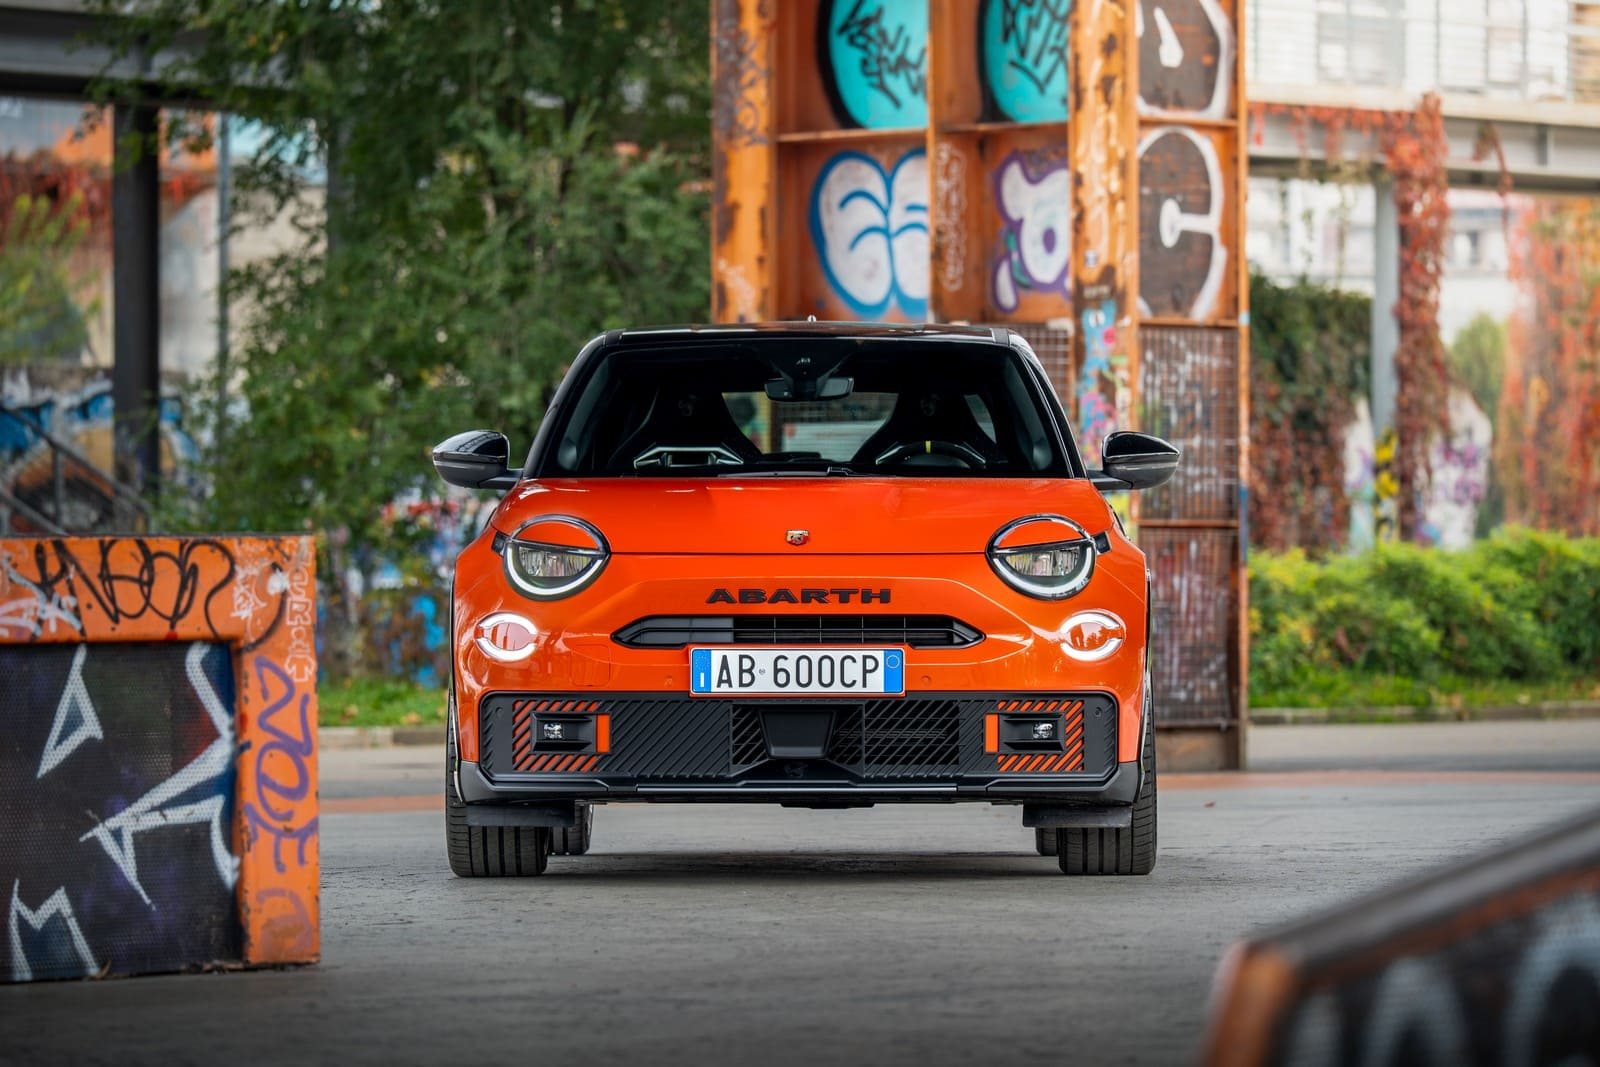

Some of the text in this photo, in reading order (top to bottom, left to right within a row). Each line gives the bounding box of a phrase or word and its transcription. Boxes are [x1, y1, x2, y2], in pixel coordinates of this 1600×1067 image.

[705, 588, 891, 604] ABARTH
[716, 654, 880, 688] AB 600CP
